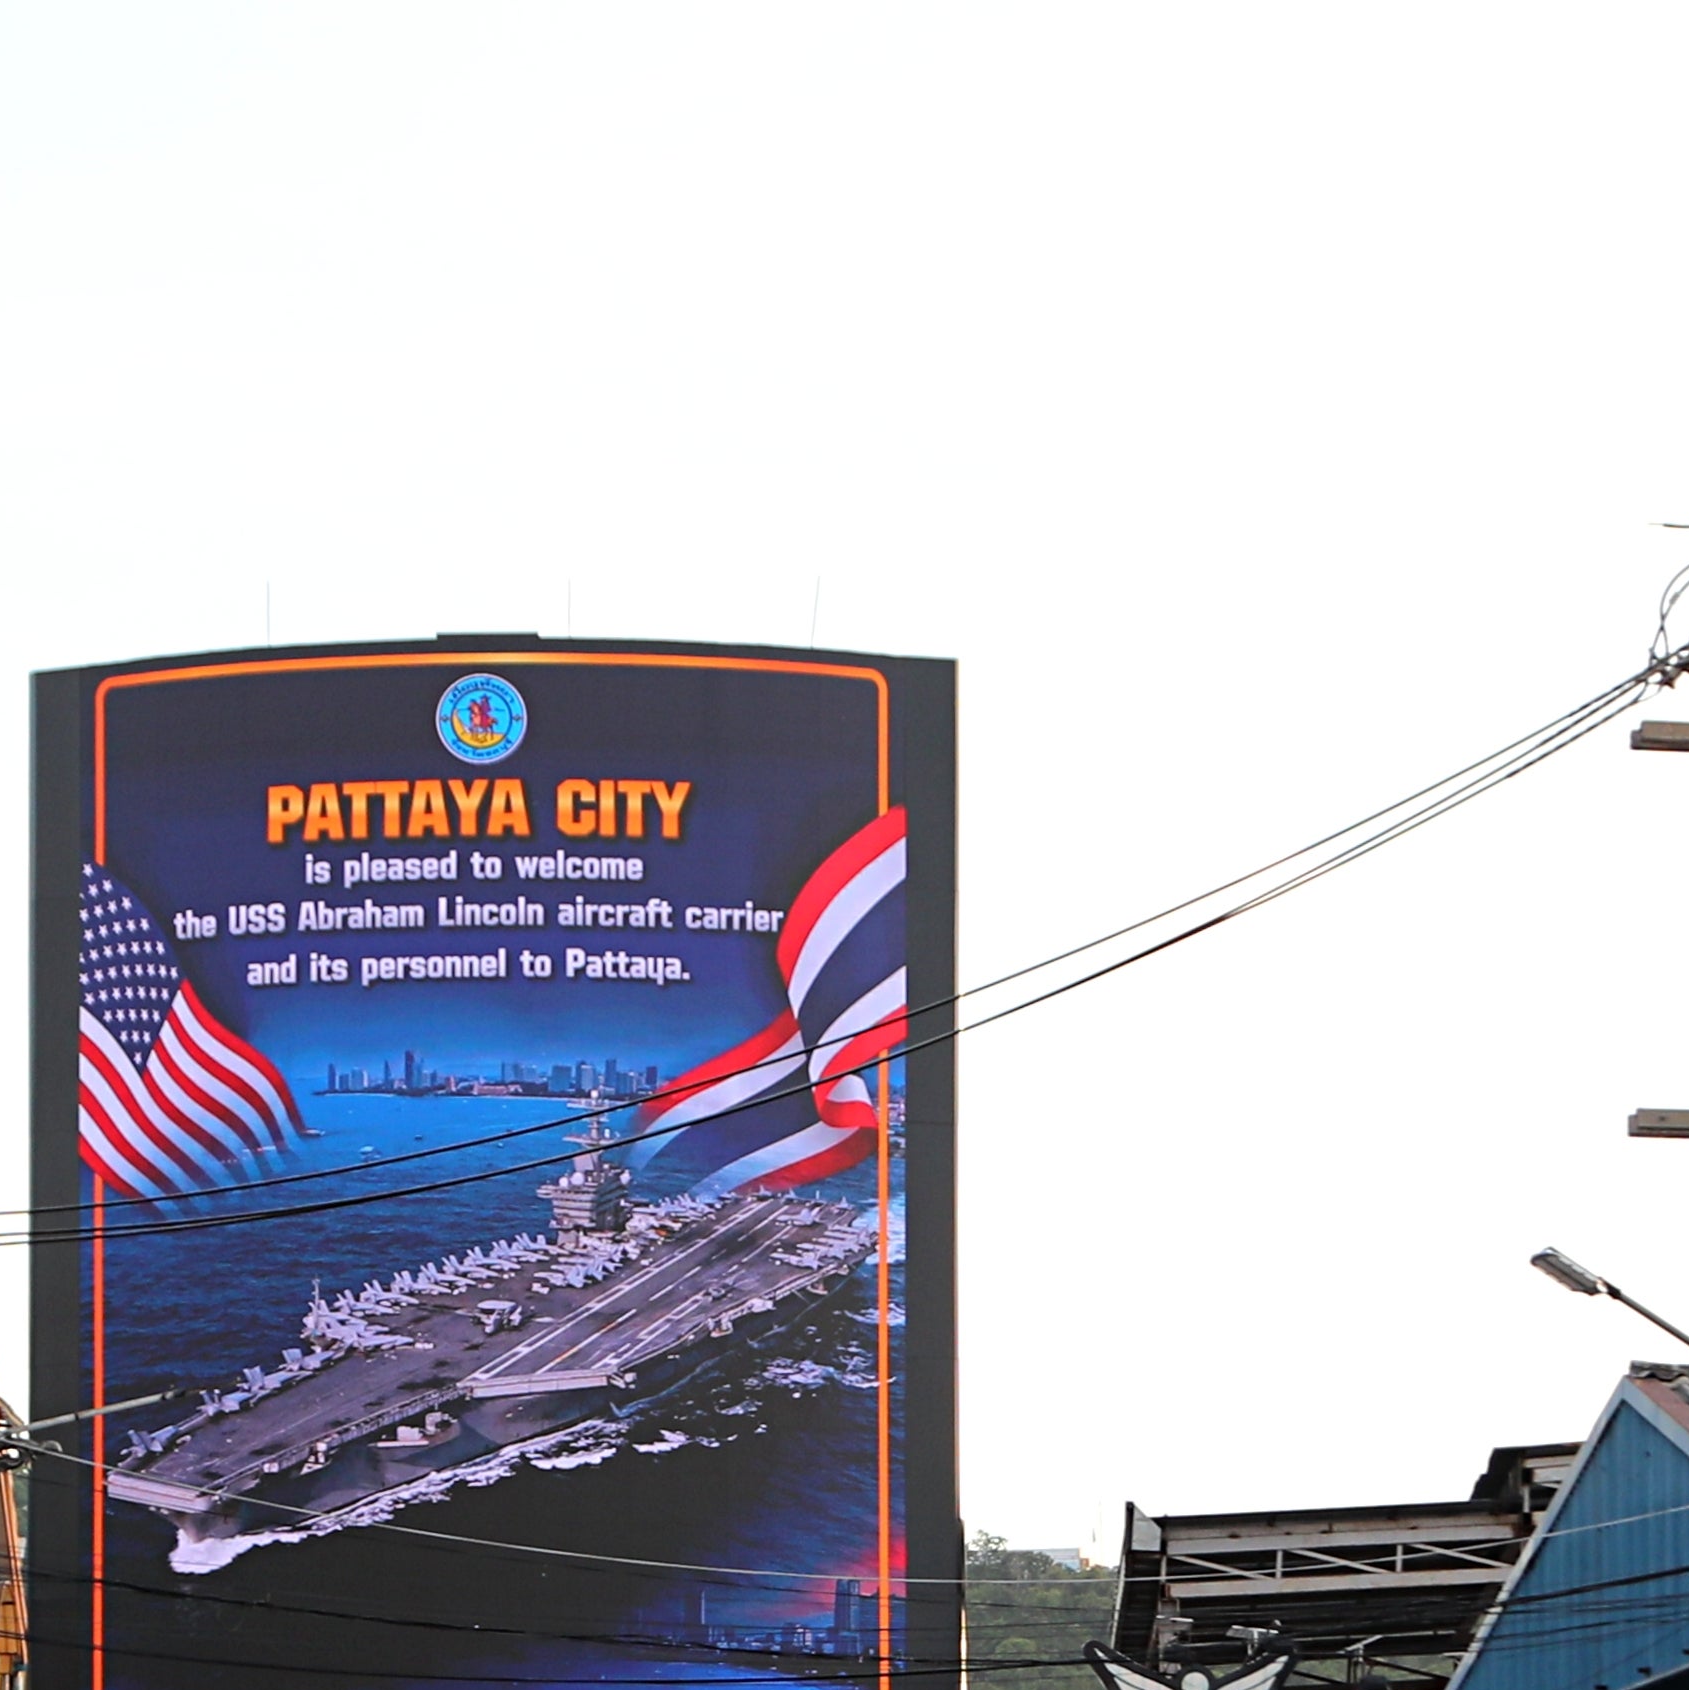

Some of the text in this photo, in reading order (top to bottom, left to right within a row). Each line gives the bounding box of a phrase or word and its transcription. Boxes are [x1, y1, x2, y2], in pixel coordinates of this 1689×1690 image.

[267, 778, 691, 843] PATTAYA CITY
[305, 850, 644, 889] is pleased to welcome
[173, 896, 784, 940] the USS Abraham Lincoln aircraft carrier
[247, 947, 691, 987] and its personnel to Pattaya.
